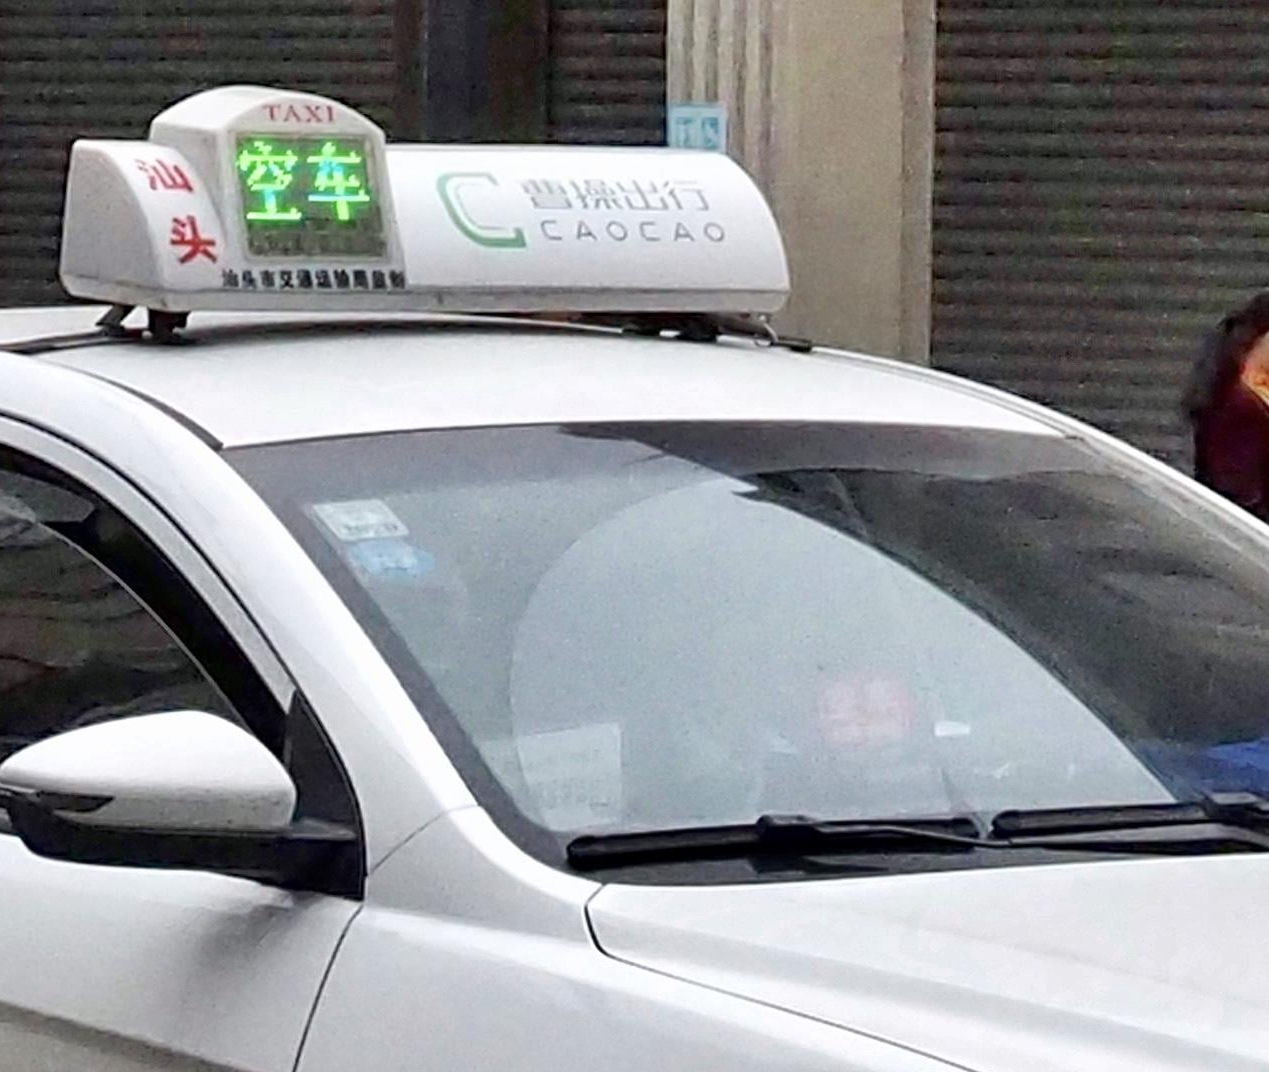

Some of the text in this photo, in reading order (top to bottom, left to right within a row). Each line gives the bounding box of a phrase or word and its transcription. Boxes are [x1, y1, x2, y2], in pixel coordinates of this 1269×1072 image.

[262, 104, 337, 124] TAXI
[237, 141, 371, 221] 空车
[518, 179, 711, 212] 曹操出行
[135, 158, 218, 264] 汕头
[540, 220, 725, 243] CAOCAO
